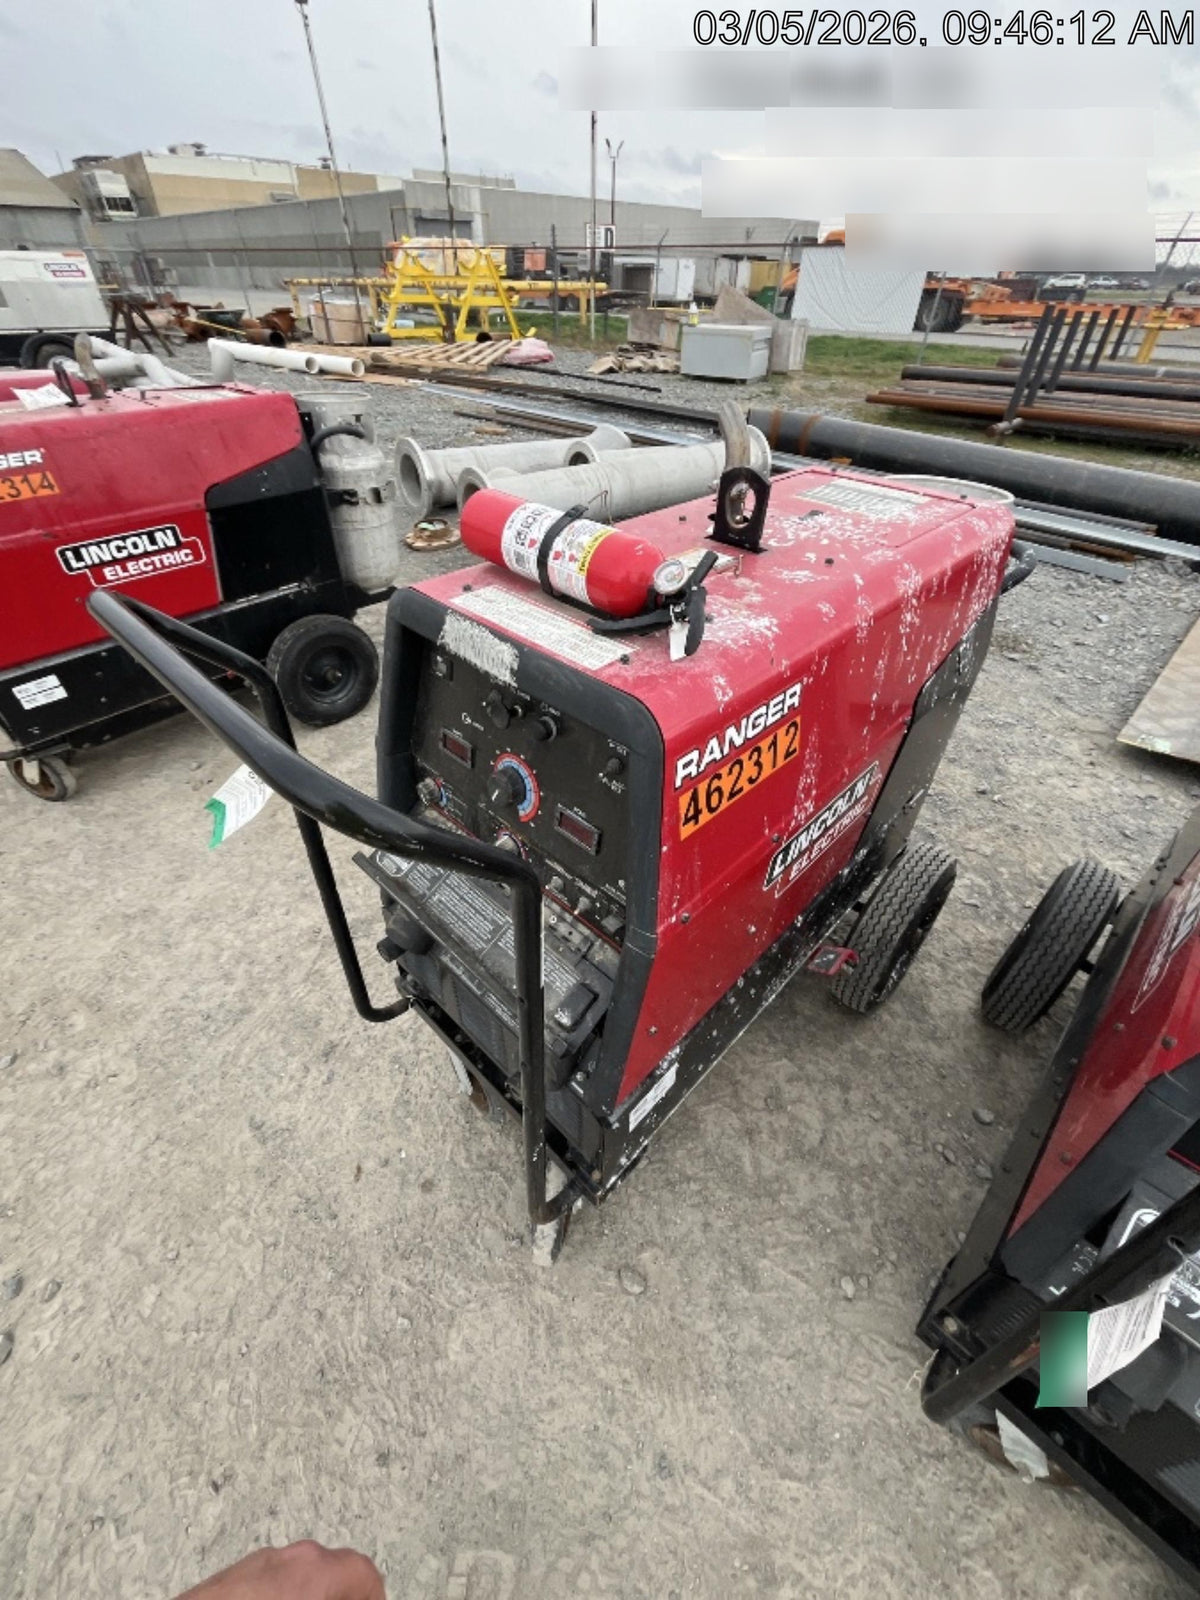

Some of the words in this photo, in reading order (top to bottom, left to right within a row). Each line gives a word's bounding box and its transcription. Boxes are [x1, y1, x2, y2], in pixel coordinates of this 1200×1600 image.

[65, 529, 177, 569] LINCOLN
[103, 549, 194, 581] ELECTRIC
[674, 682, 802, 789] RANGER
[682, 720, 799, 827] 462312
[772, 773, 870, 878] LINCOLN
[789, 796, 869, 881] ELECTRIC
